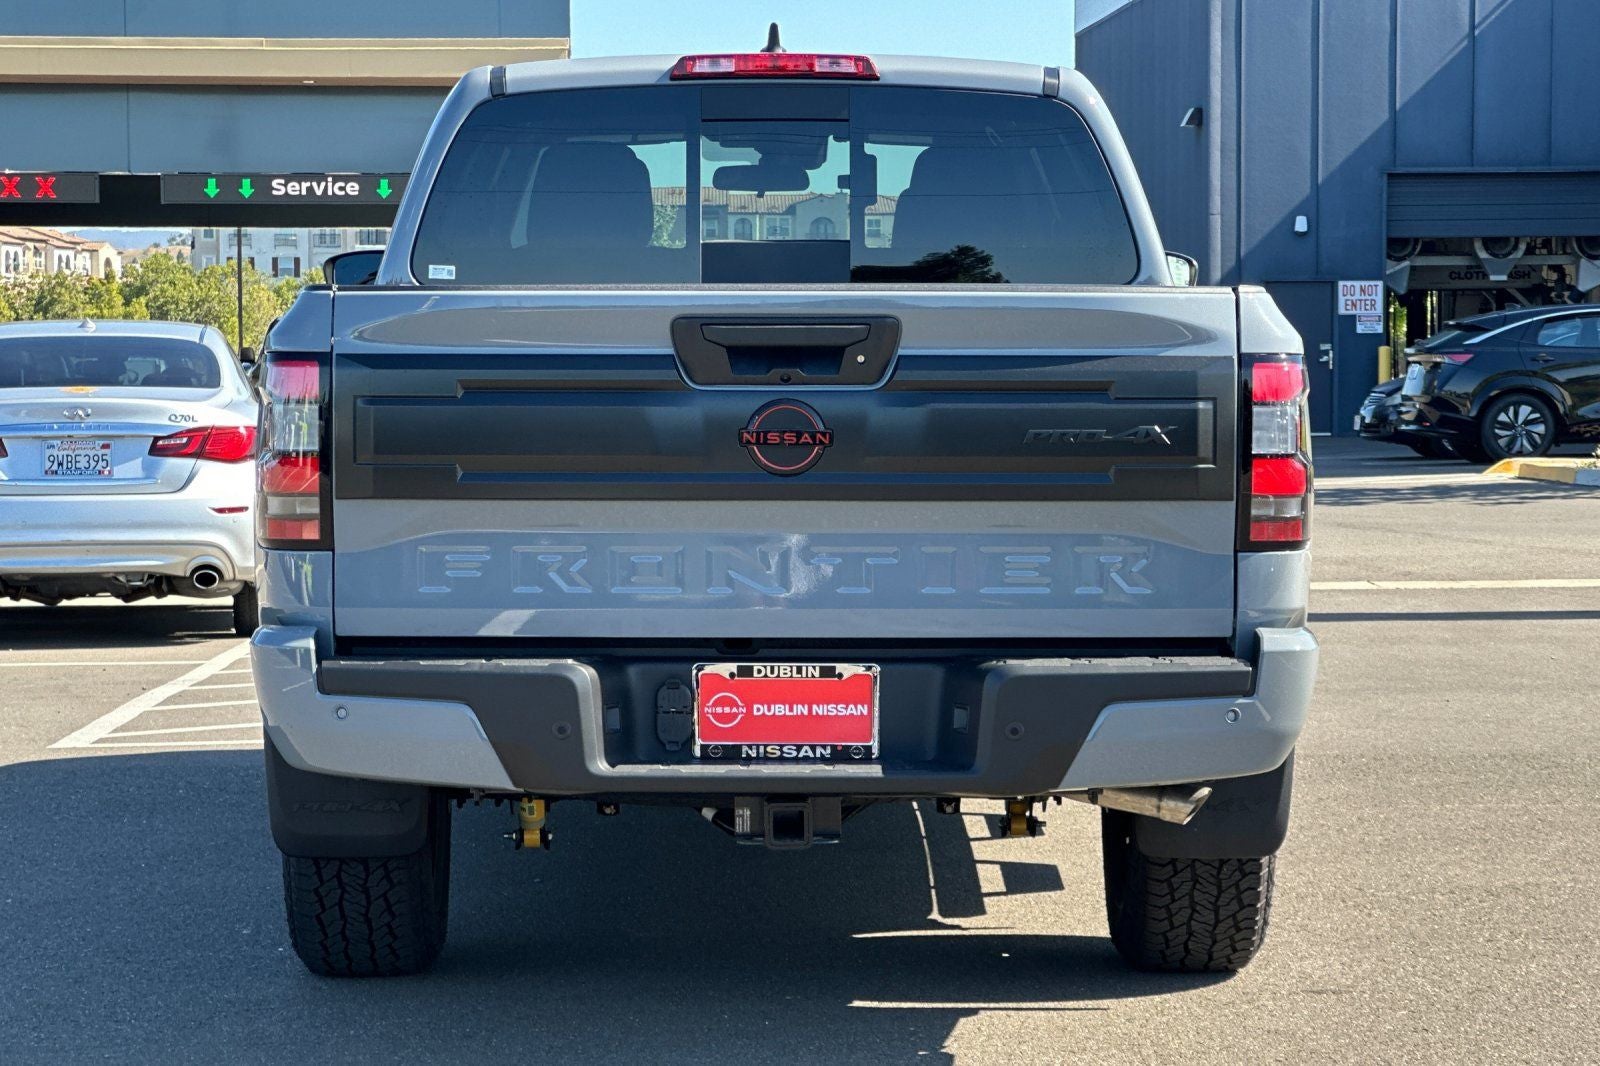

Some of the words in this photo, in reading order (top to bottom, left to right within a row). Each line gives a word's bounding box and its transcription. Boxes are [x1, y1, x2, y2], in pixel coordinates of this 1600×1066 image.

[271, 177, 360, 196] Service
[1342, 284, 1356, 297] DO
[1360, 284, 1380, 297] NOT
[1344, 298, 1377, 312] ENTER
[168, 413, 198, 424] Q70L
[742, 432, 830, 444] NISSAN
[1023, 425, 1179, 445] PRO-4X
[47, 453, 109, 470] 9WBE395
[417, 544, 1153, 596] FRONTIER
[753, 665, 820, 678] DUBLIN
[704, 706, 746, 714] NISSAN
[753, 704, 808, 716] DUBLIN
[812, 704, 868, 716] NISSAN
[741, 745, 832, 758] NISSAN
